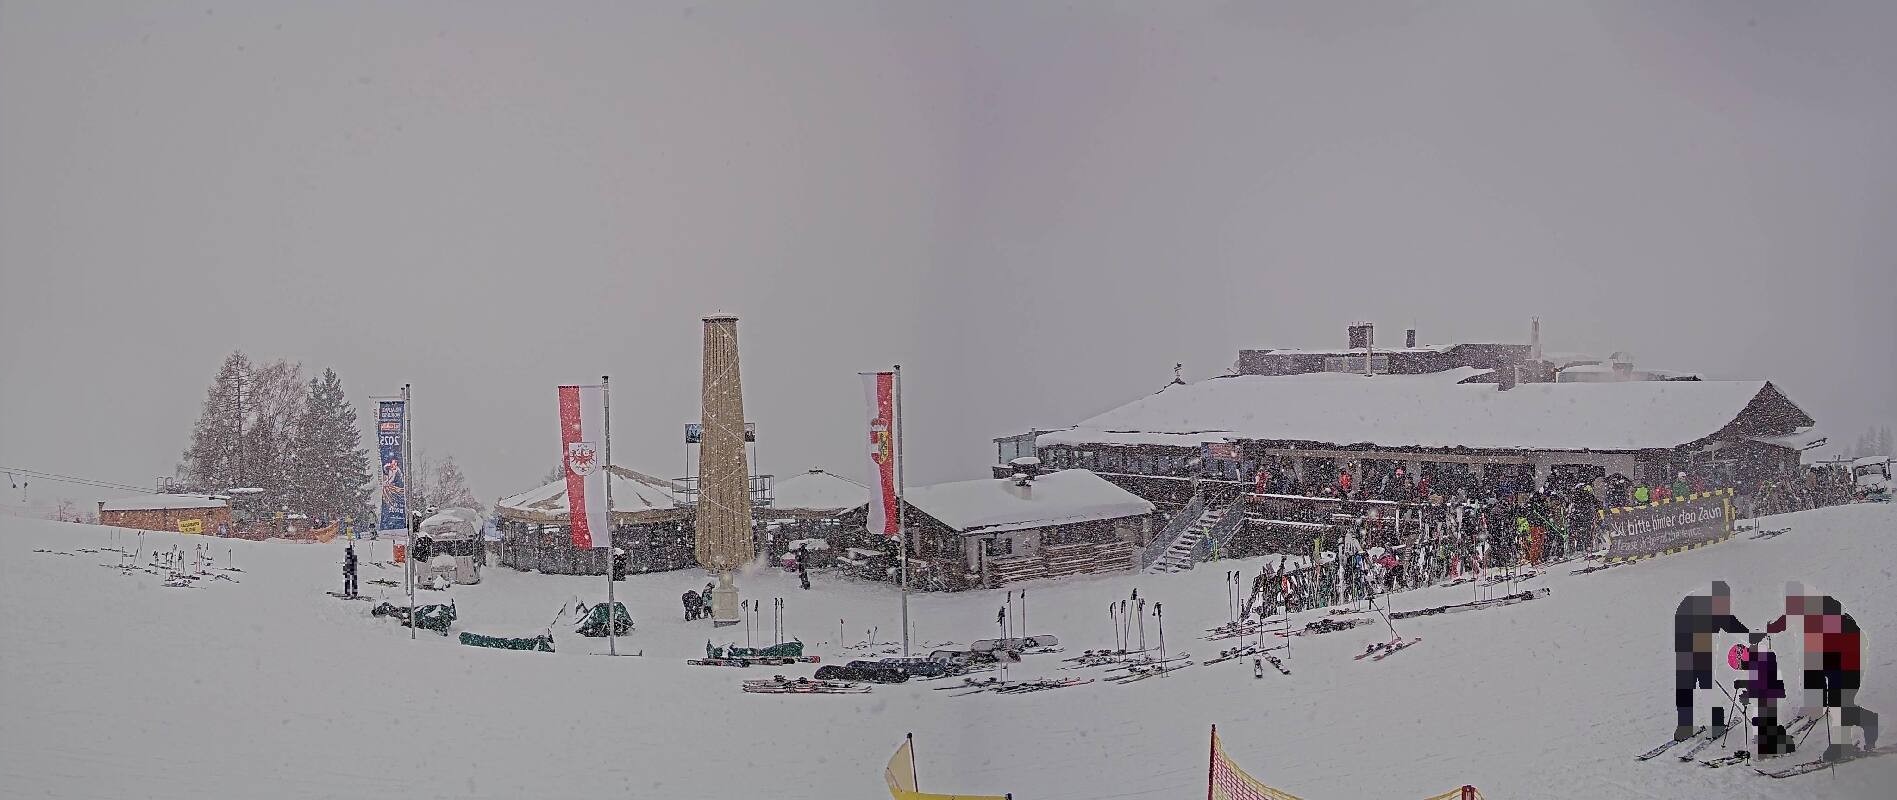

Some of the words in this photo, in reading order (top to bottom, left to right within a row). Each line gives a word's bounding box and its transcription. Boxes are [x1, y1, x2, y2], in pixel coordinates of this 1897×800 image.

[1627, 519, 1652, 536] bitte
[1678, 509, 1696, 525] den
[1698, 506, 1722, 522] Zaun
